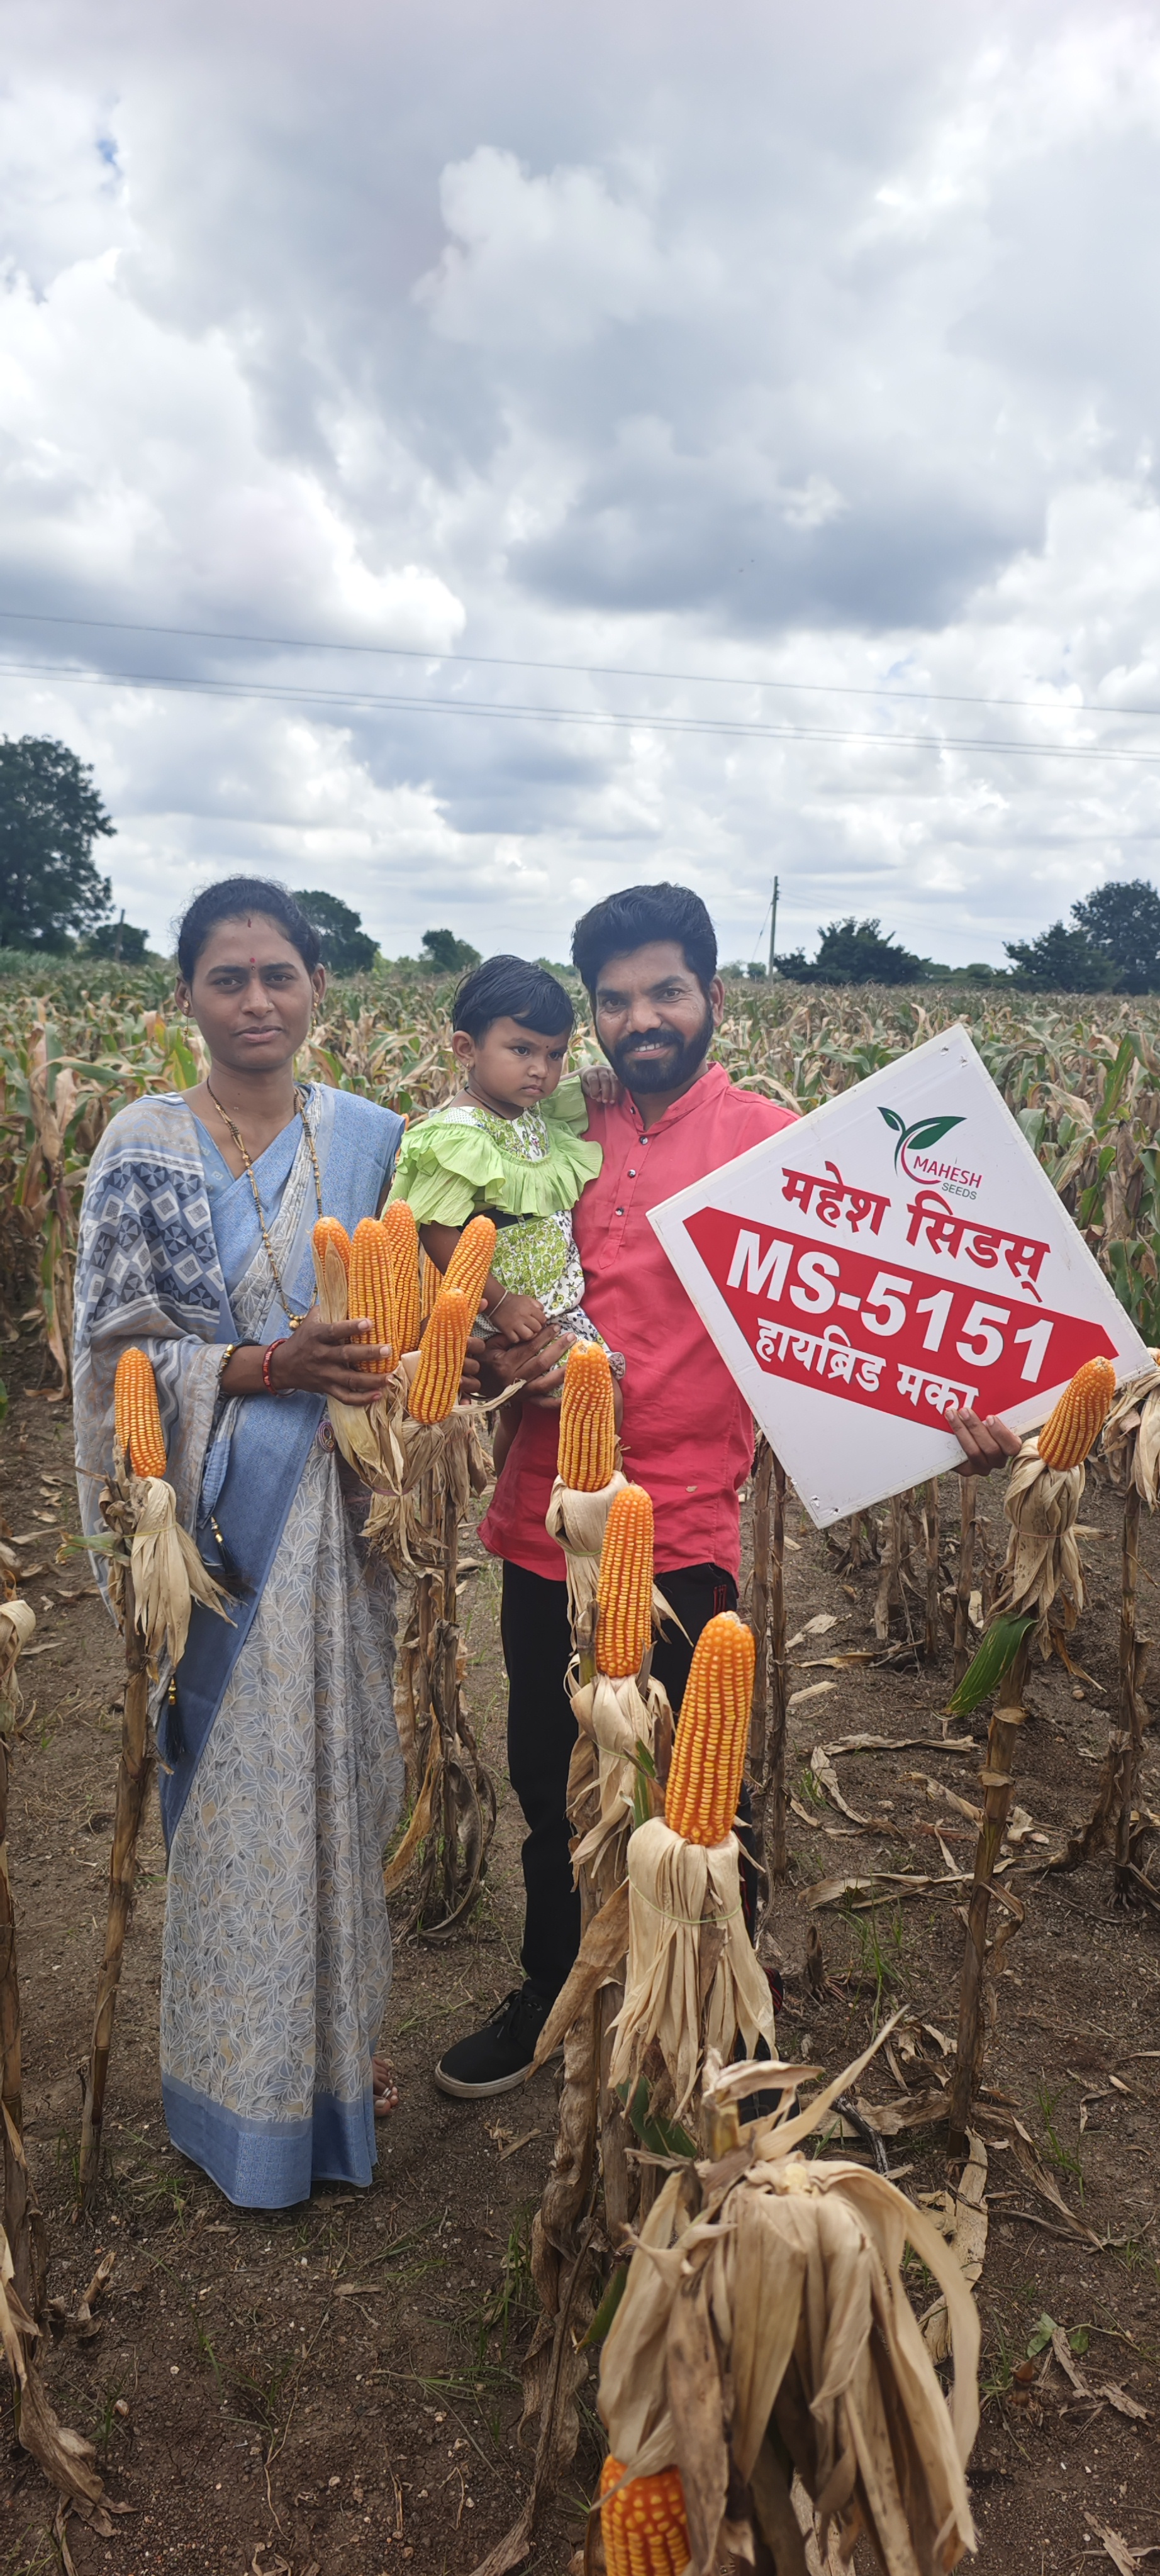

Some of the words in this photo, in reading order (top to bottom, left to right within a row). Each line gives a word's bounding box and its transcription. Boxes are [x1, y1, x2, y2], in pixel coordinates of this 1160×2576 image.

[913, 1155, 983, 1188] MAHESH
[942, 1182, 977, 1200] SEEDS
[781, 1161, 891, 1234] महेश
[906, 1191, 1051, 1302] सिडस्
[726, 1229, 1054, 1383] MS-5151
[756, 1318, 886, 1392] हायब्रिड
[896, 1363, 979, 1415] मका
